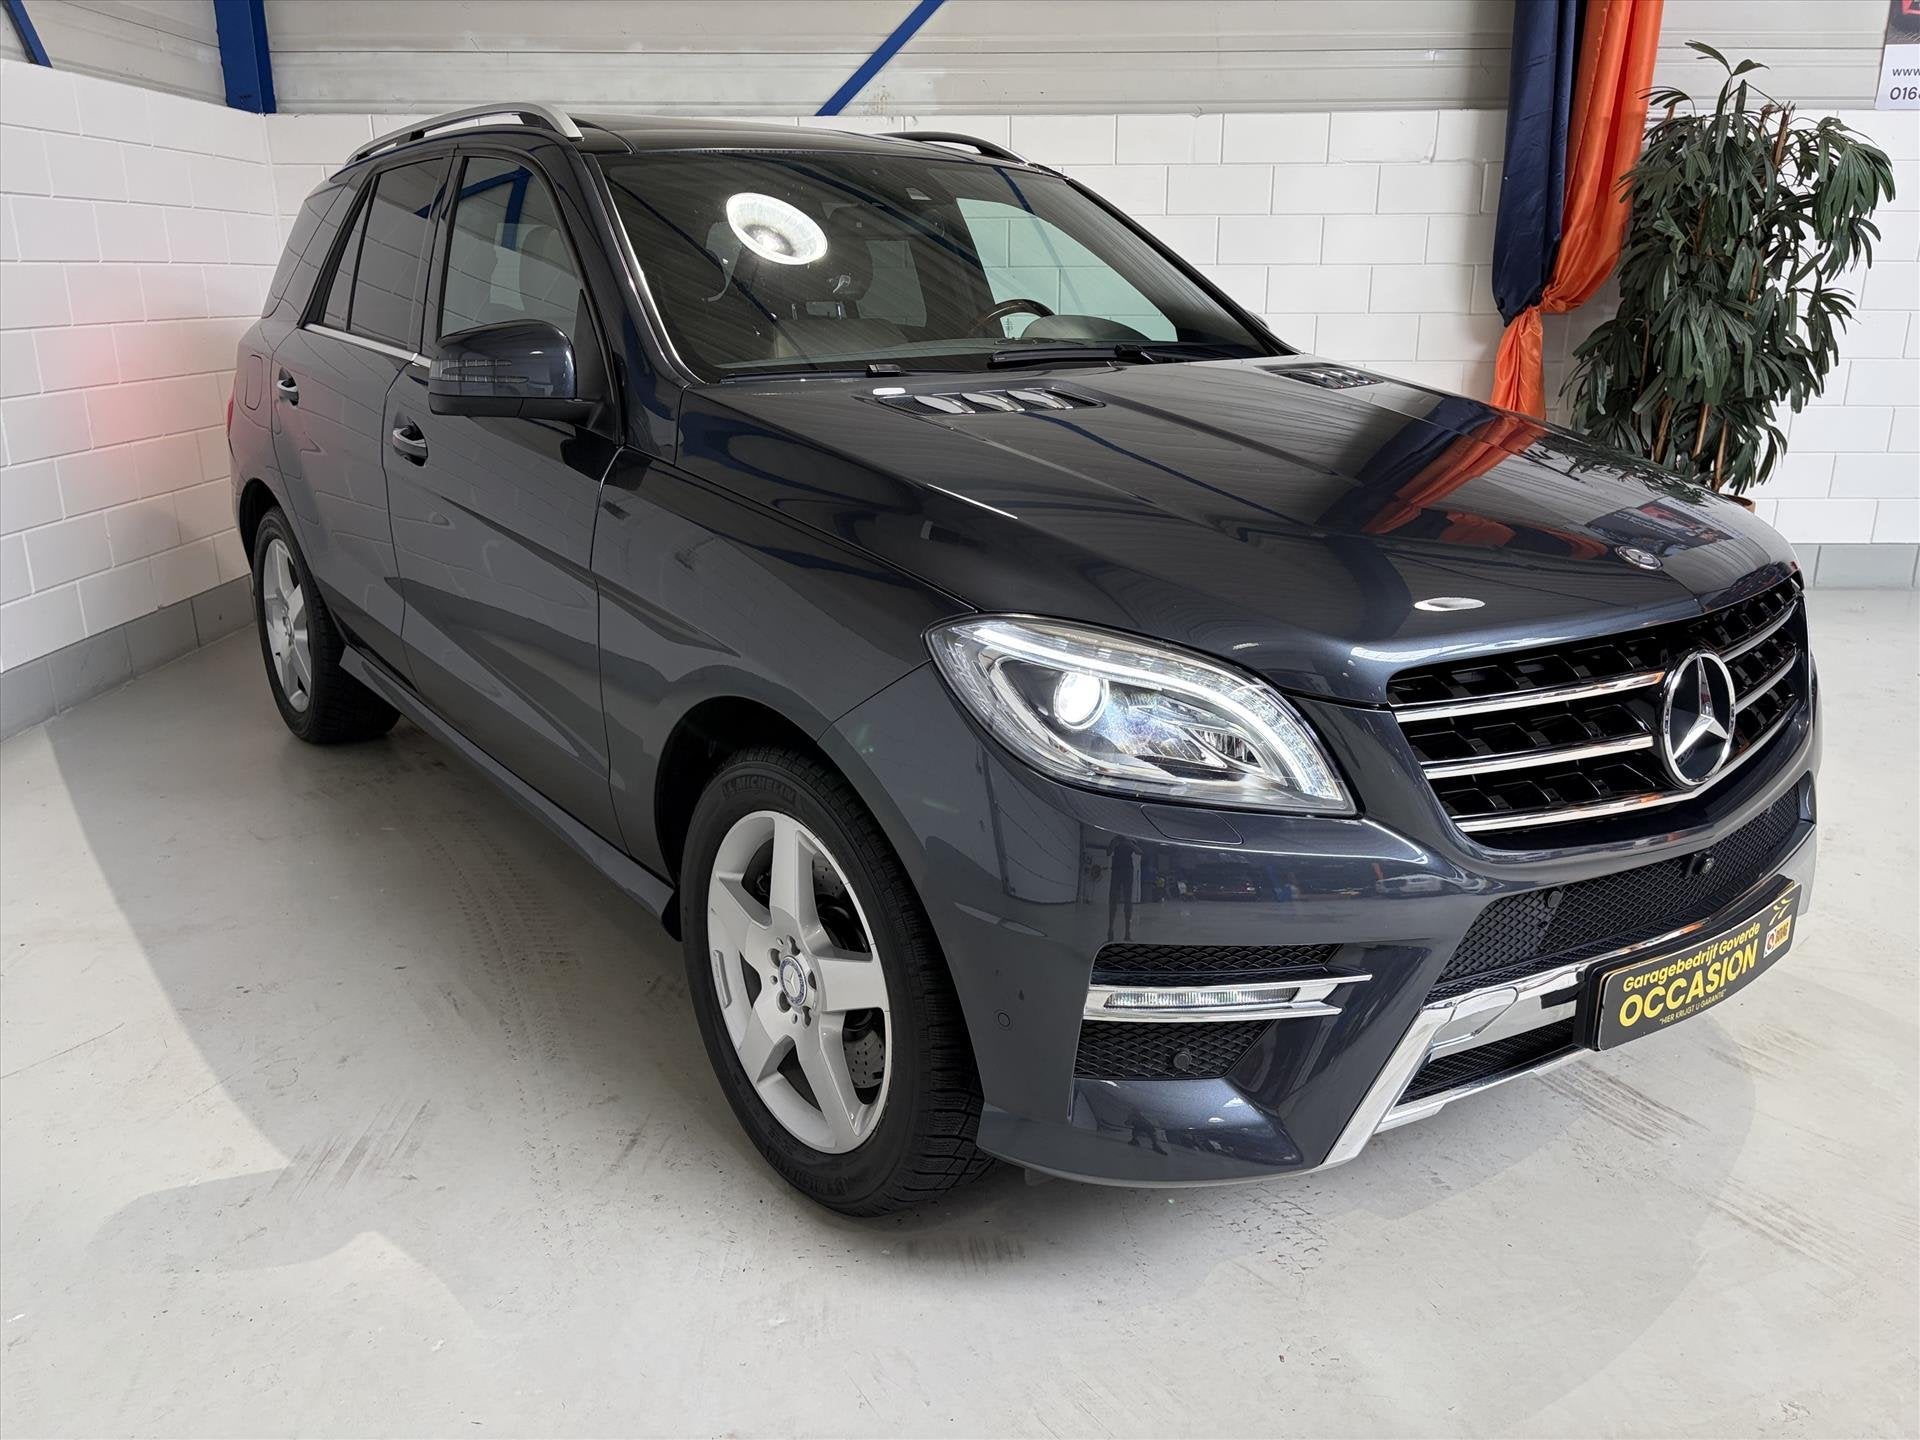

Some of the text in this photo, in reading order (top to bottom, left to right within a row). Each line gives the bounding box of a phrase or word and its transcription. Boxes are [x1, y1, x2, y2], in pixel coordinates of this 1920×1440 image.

[1889, 86, 1920, 100] 016
[1618, 938, 1758, 1027] OCCASION
[1623, 942, 1718, 992] Garagebedrijf
[1719, 922, 1760, 955] Goverde
